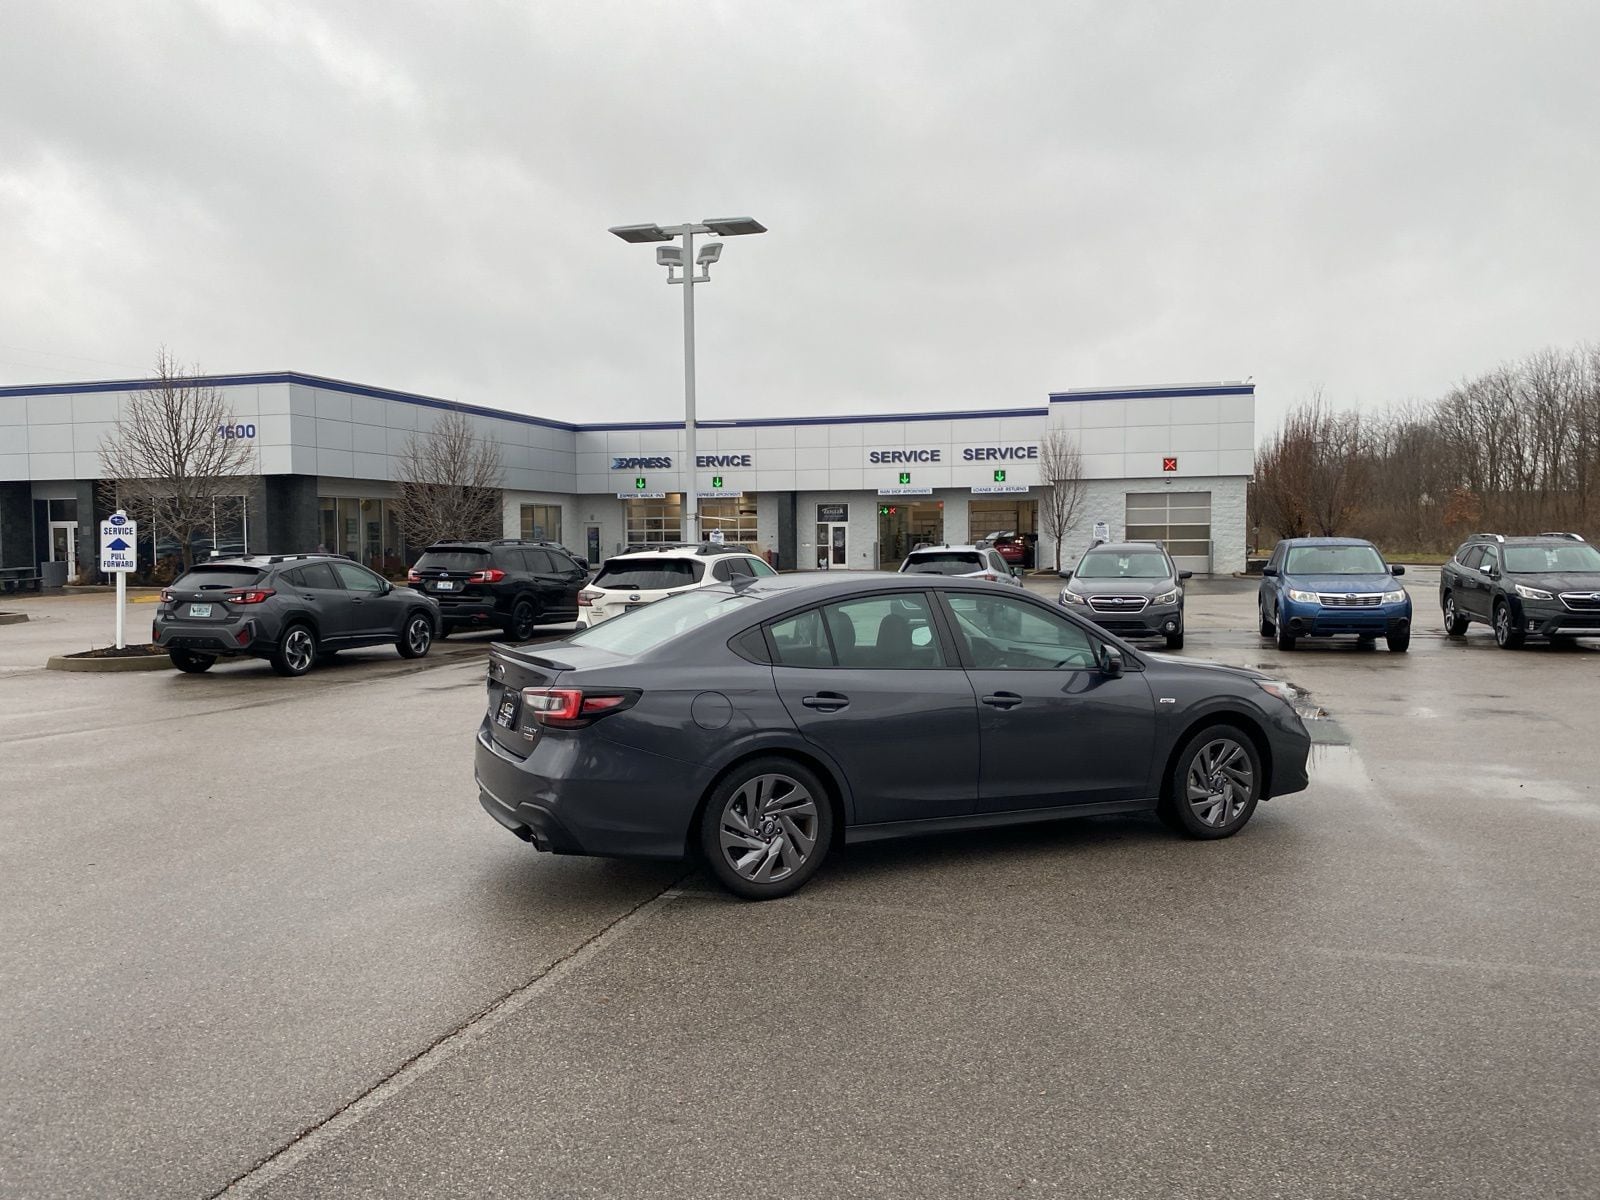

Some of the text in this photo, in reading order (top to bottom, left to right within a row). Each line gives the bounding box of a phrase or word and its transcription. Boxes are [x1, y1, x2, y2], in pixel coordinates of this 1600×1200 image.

[218, 424, 256, 439] 1600
[869, 449, 941, 464] SERVICE
[962, 446, 1039, 461] SERVICE
[611, 454, 752, 470] EXPRESS ERVICE
[103, 527, 134, 535] SERVICE
[103, 560, 134, 568] FORWARD
